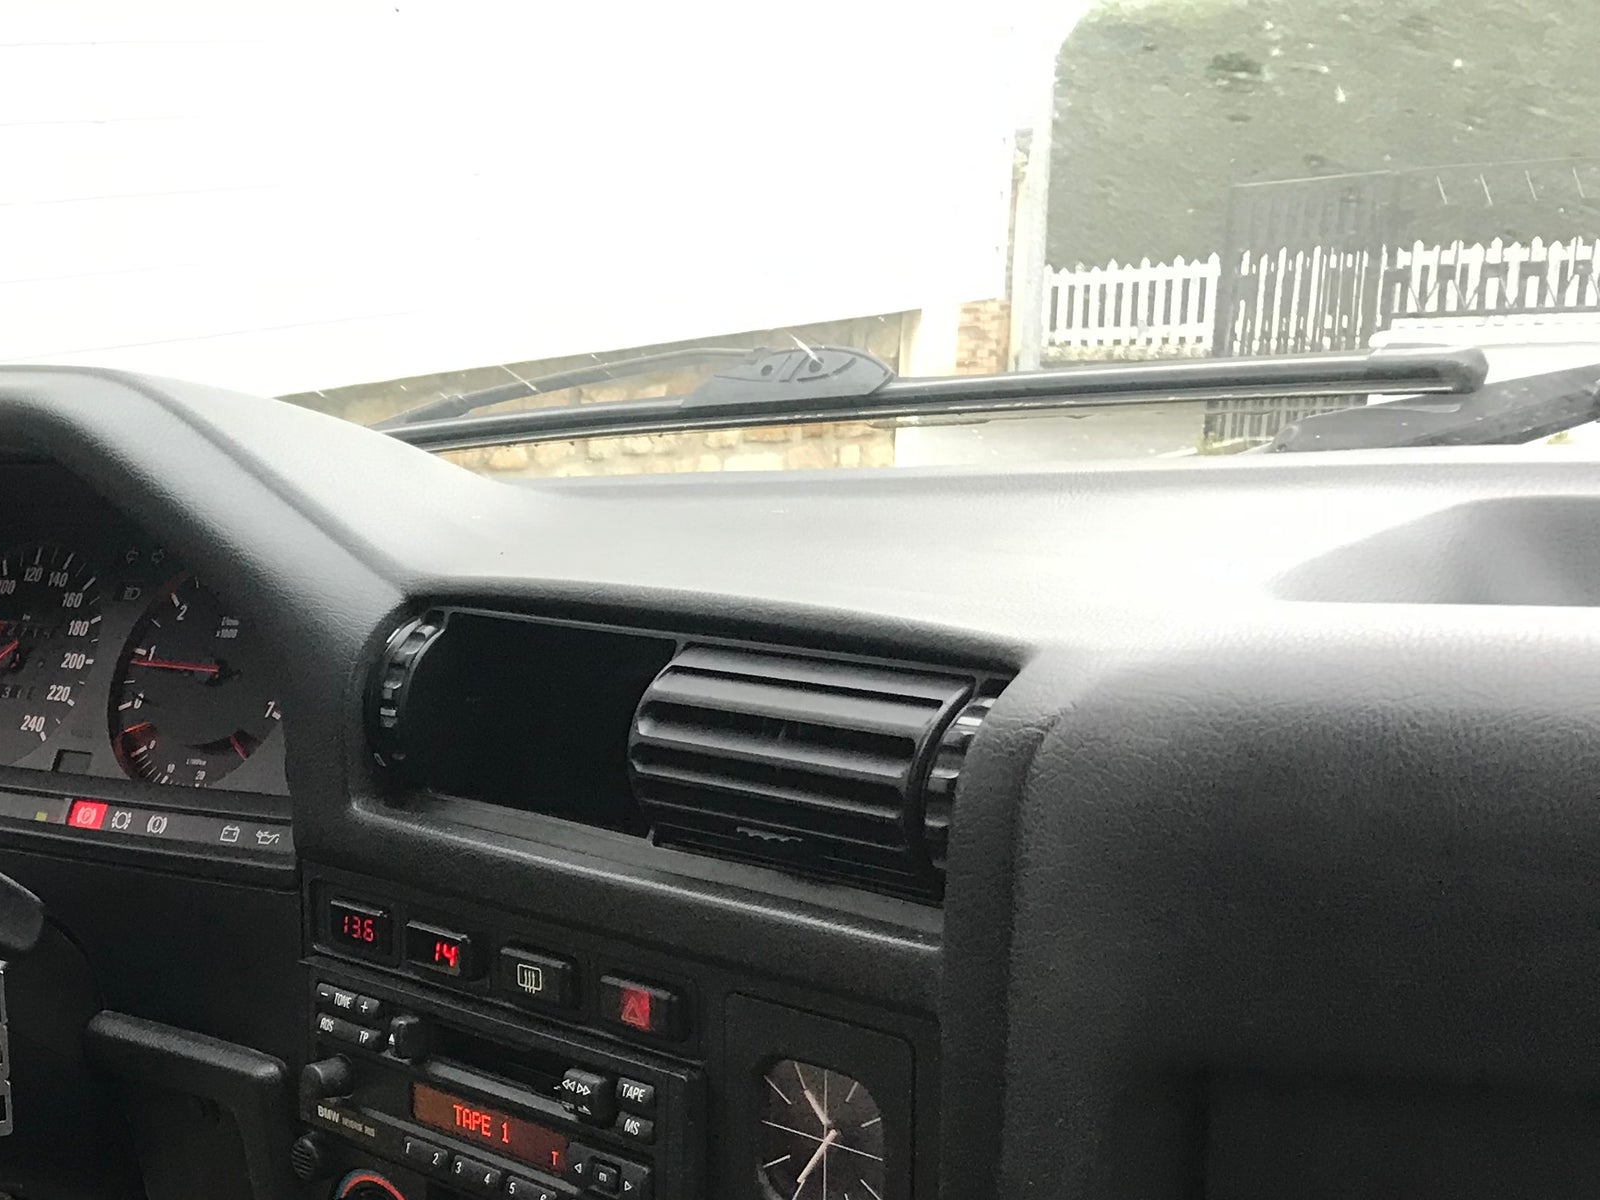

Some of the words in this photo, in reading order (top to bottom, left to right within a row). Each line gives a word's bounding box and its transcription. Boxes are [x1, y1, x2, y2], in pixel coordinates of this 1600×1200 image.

[24, 567, 43, 582] 120
[48, 571, 68, 587] 140
[62, 592, 83, 608] 160
[176, 605, 187, 621] 2
[67, 620, 89, 636] 180
[148, 645, 156, 661] 1
[61, 653, 86, 670] 200
[46, 685, 71, 701] 220
[20, 714, 45, 732] 240
[434, 941, 458, 967] 14
[333, 992, 351, 1009] TONE
[359, 1030, 369, 1043] TP
[622, 1083, 645, 1103] TAPE
[317, 1104, 340, 1123] BMW
[453, 1103, 492, 1137] TAPE
[501, 1122, 509, 1143] 1
[624, 1118, 640, 1136] MS
[405, 1142, 411, 1154] 1
[432, 1152, 439, 1165] 2
[551, 1151, 559, 1166] T
[455, 1161, 462, 1174] 3
[483, 1173, 491, 1185] 4
[509, 1182, 517, 1195] 5
